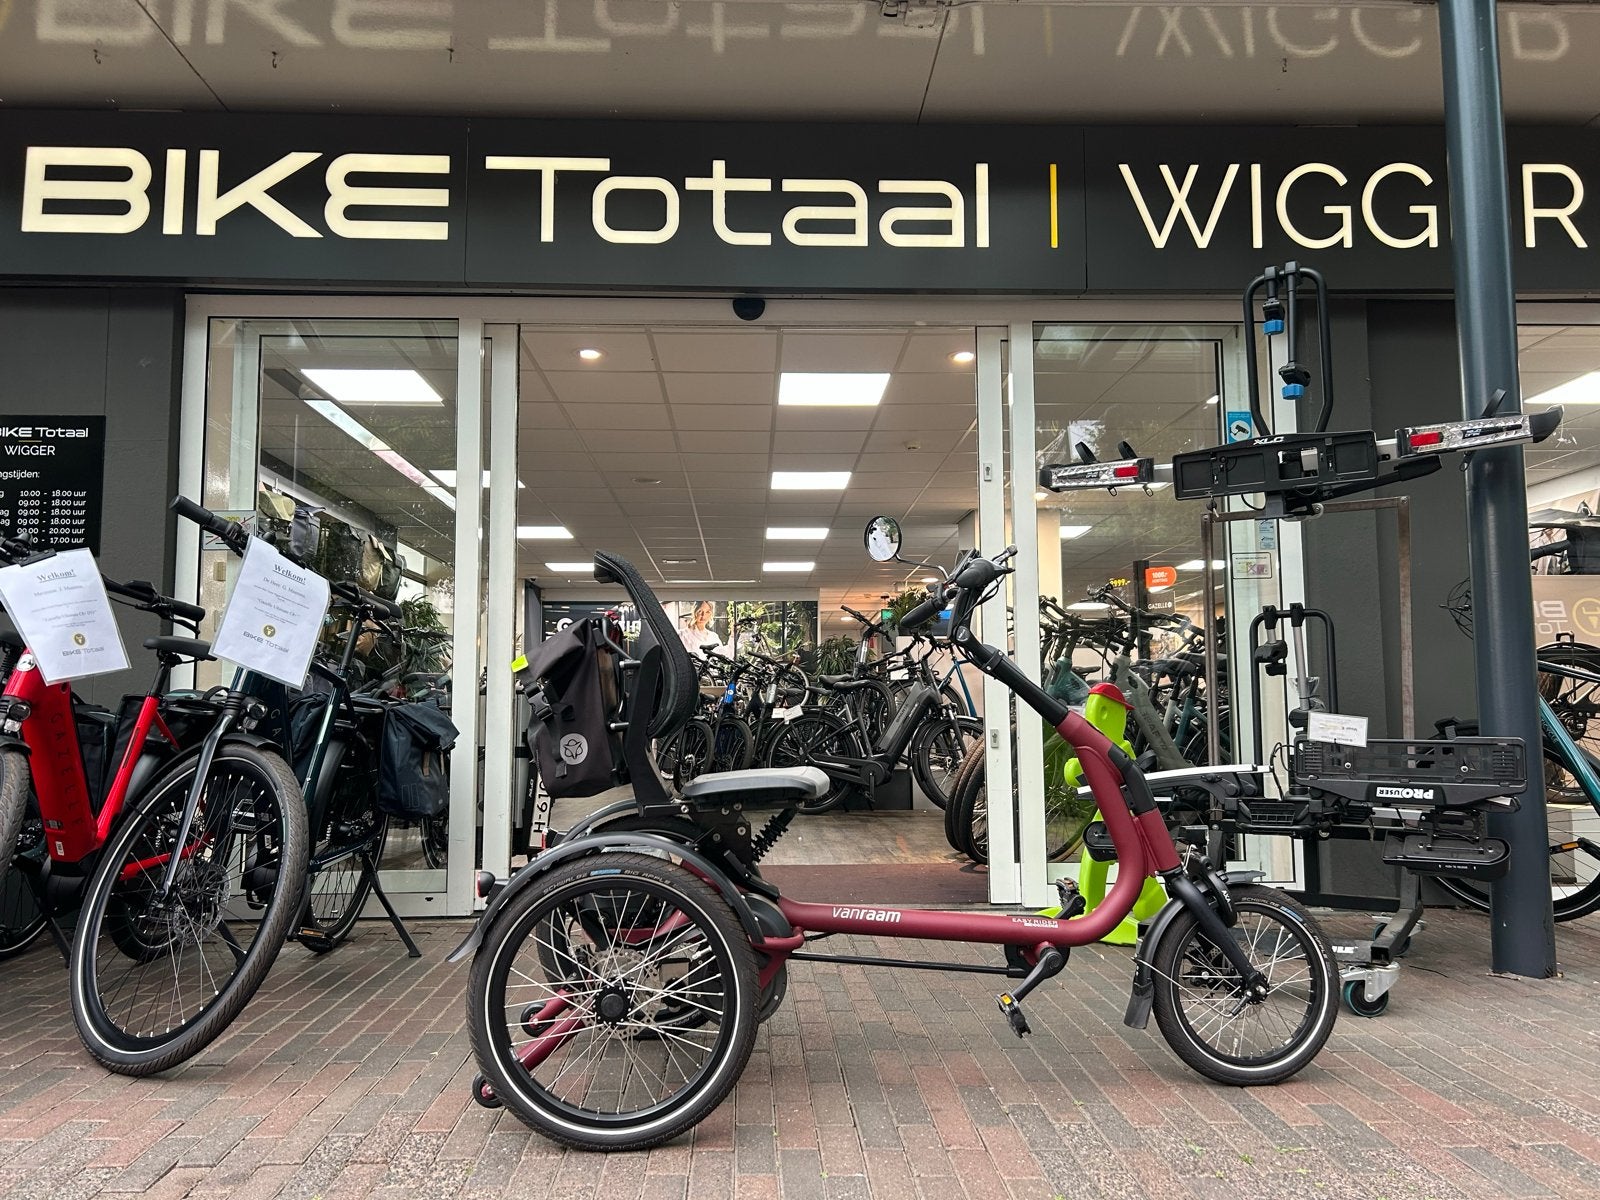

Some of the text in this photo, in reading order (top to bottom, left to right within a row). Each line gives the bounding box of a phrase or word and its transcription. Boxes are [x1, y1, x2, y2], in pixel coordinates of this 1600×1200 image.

[21, 146, 1588, 250] BIKE Totaal WIGGR
[35, 427, 89, 438] Totaal
[1253, 436, 1284, 445] XLC
[4, 445, 56, 456] WIGGER
[52, 489, 72, 497] 18.00
[18, 499, 40, 507] 09.00
[18, 508, 40, 516] 09.00
[51, 508, 71, 516] 18.00
[50, 517, 71, 525] 18.00
[37, 569, 76, 582] Welkom!
[273, 563, 307, 585] Welkom!
[1148, 602, 1168, 610] GAZELLE
[50, 712, 84, 825] GAZELLE
[1221, 890, 1231, 903] AXA
[832, 906, 901, 923] vanraam
